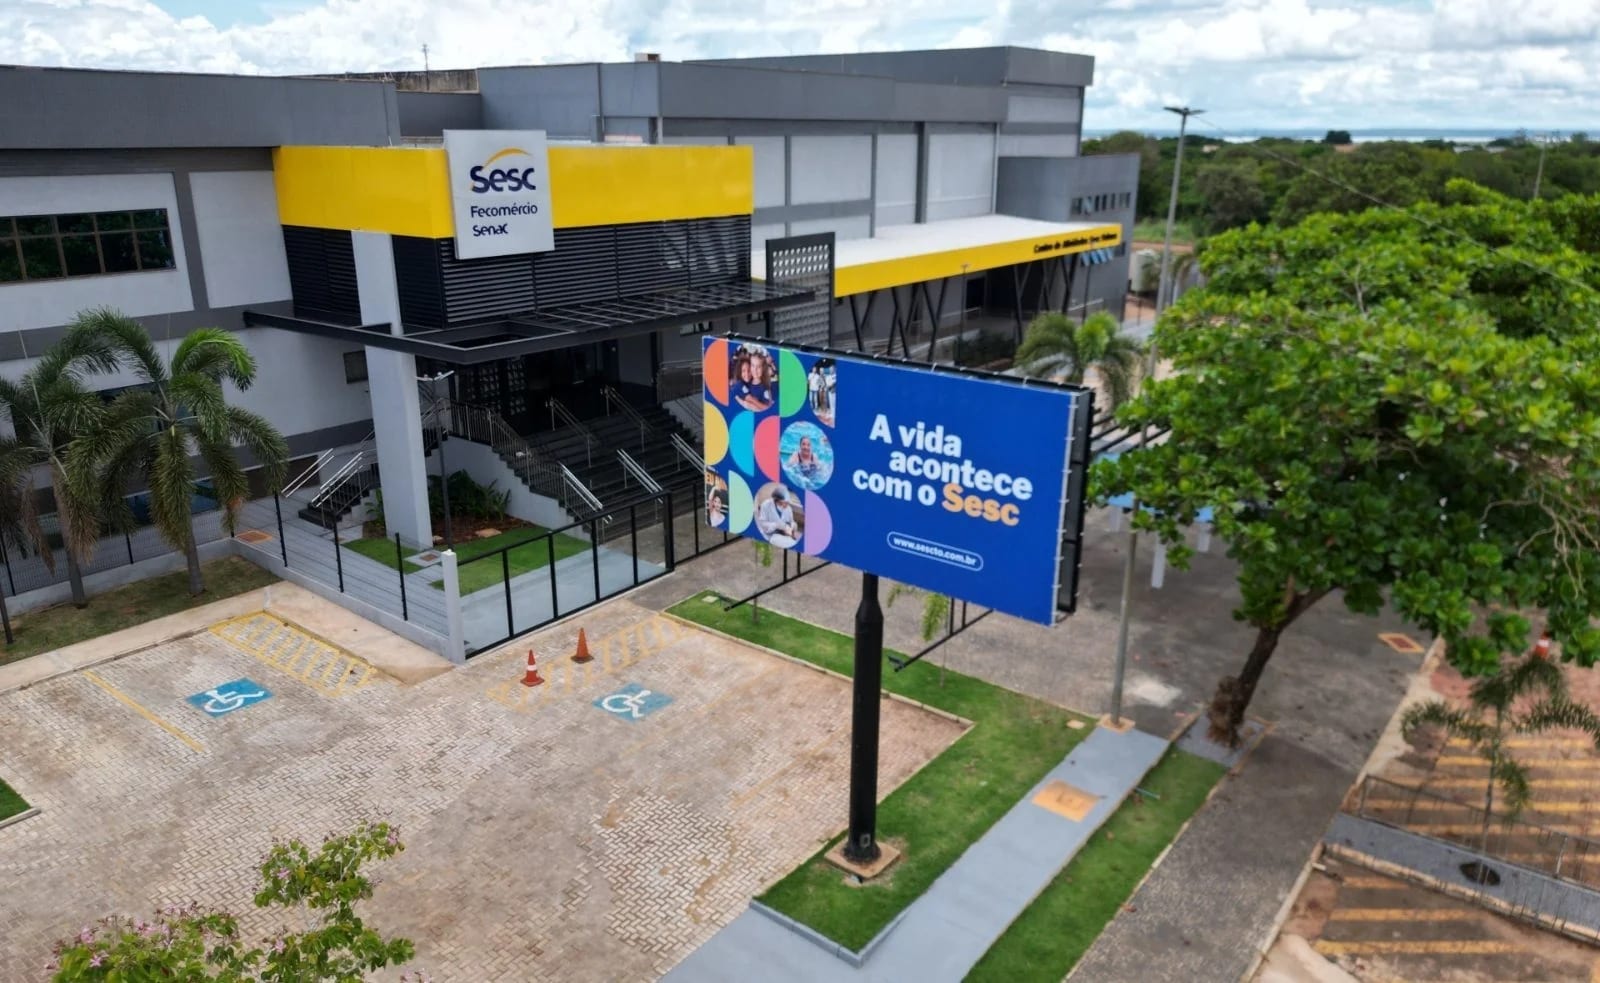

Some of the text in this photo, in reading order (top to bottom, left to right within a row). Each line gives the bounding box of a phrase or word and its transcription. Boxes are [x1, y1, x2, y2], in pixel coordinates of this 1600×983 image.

[469, 165, 537, 194] Sesc
[470, 202, 538, 218] Fecomércio
[472, 223, 509, 238] Senac
[869, 413, 962, 458] A vida
[889, 450, 1033, 500] acontece
[853, 469, 1020, 526] com o Sesc
[893, 537, 977, 566] www.sescto.com.br
